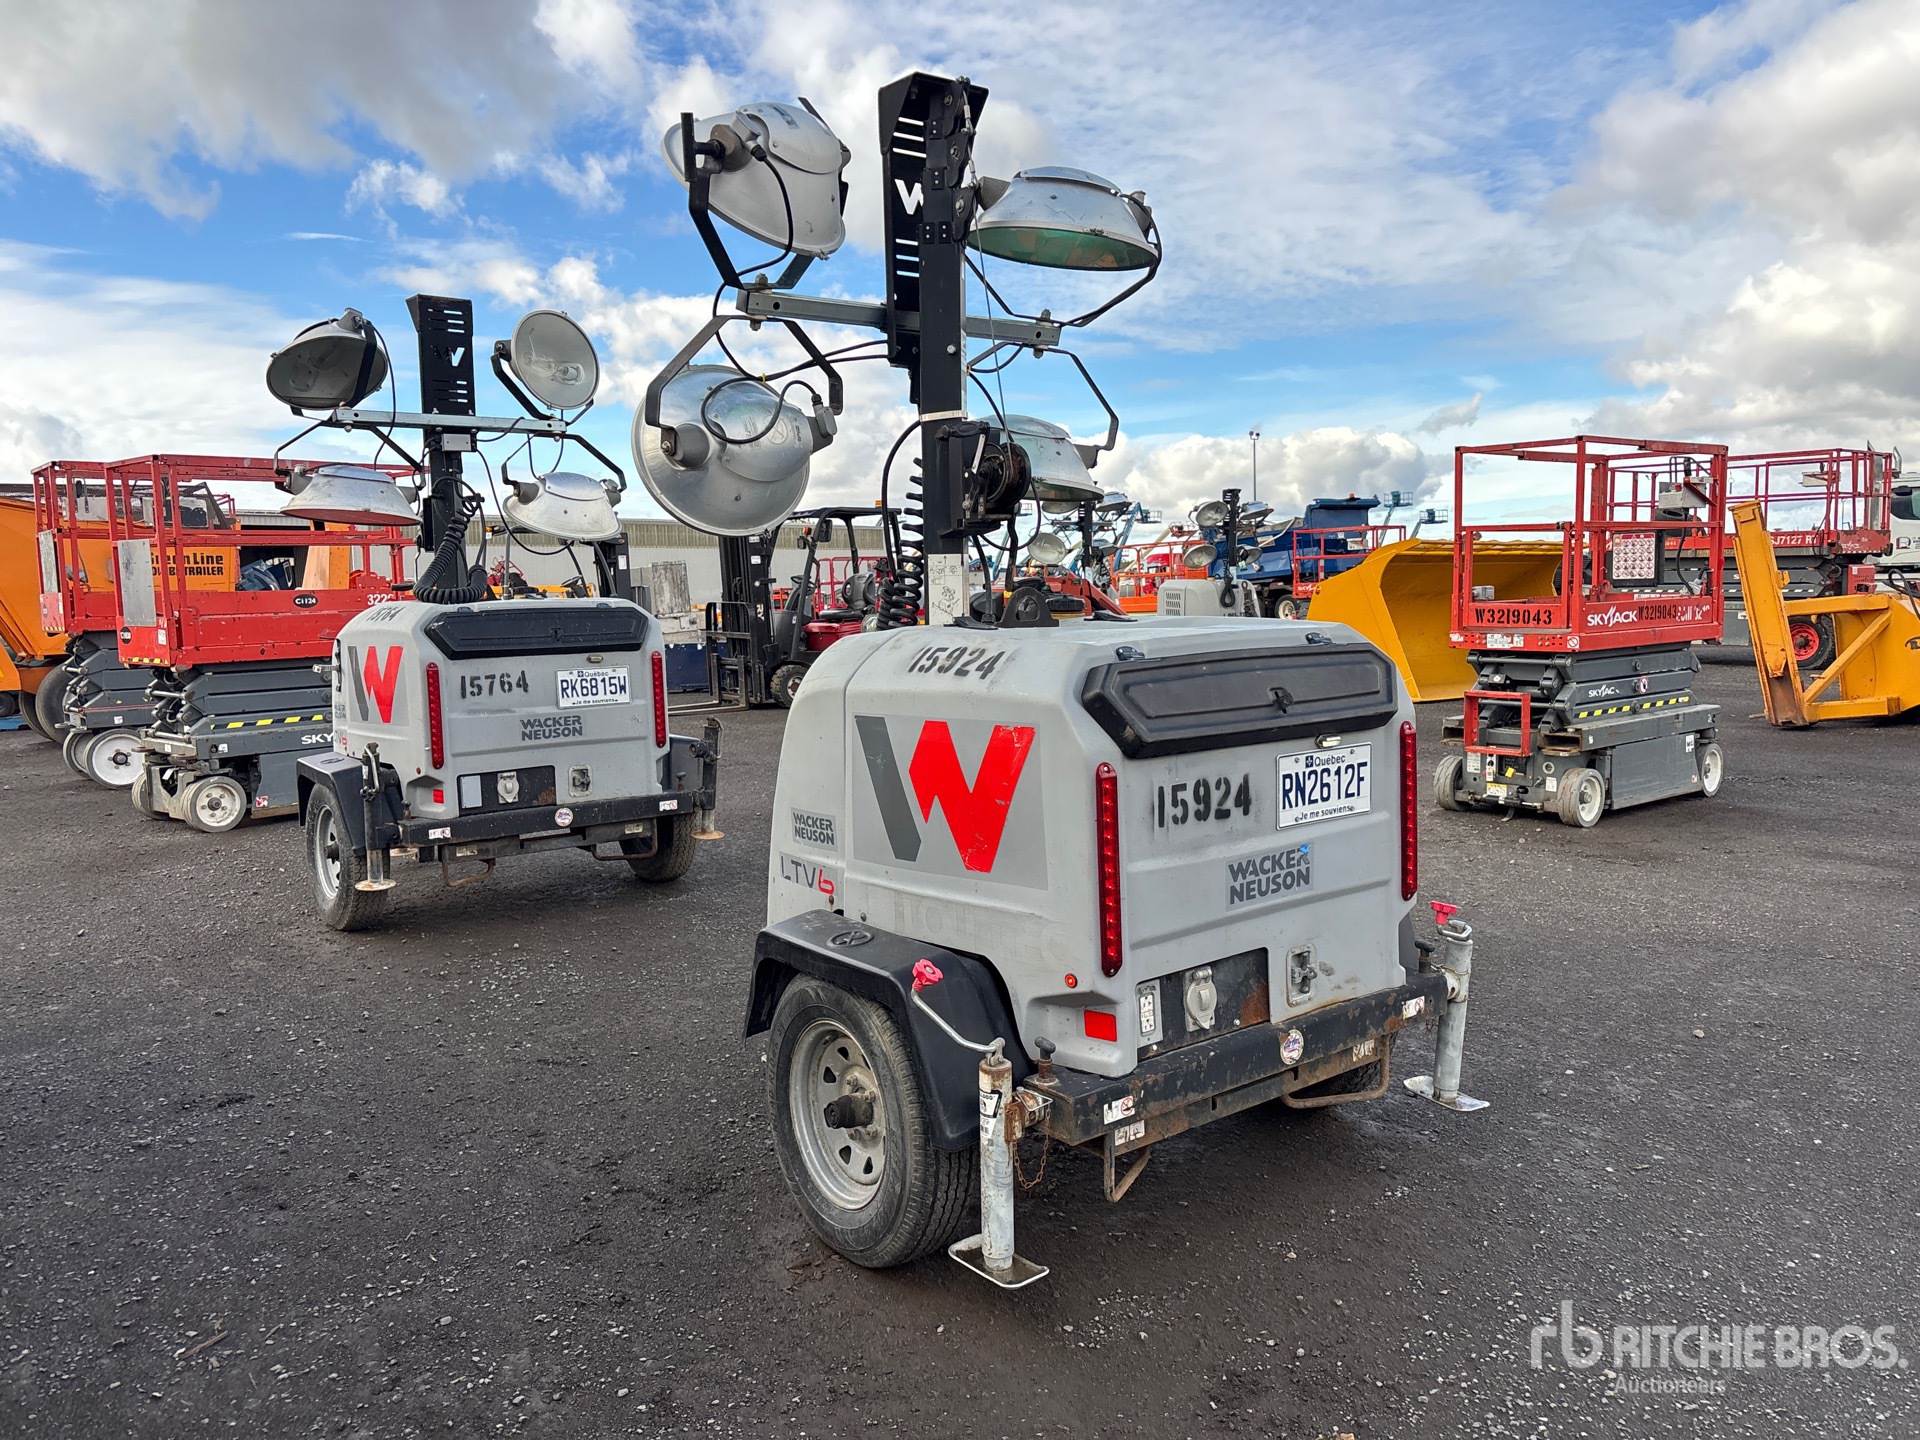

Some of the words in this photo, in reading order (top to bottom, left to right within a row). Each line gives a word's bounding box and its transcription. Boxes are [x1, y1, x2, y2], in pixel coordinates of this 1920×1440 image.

[1475, 608, 1553, 625] W3219043
[1587, 605, 1638, 627] SKYJACK
[908, 646, 1006, 680] 15924
[460, 670, 530, 699] 15764
[560, 676, 628, 699] RK6815W
[519, 714, 583, 730] WACKER
[521, 726, 584, 741] NEUSON
[1314, 753, 1347, 773] Québec
[1281, 761, 1369, 811] RN2612F
[1157, 772, 1252, 829] 15924
[792, 811, 834, 833] WACKER
[1300, 811, 1309, 821] Je
[1309, 809, 1320, 819] me
[1321, 804, 1352, 817] souviens
[794, 825, 835, 846] NEUSON
[780, 855, 835, 895] LTV6
[1228, 845, 1311, 883] WACKER
[1229, 866, 1311, 905] NEUSON
